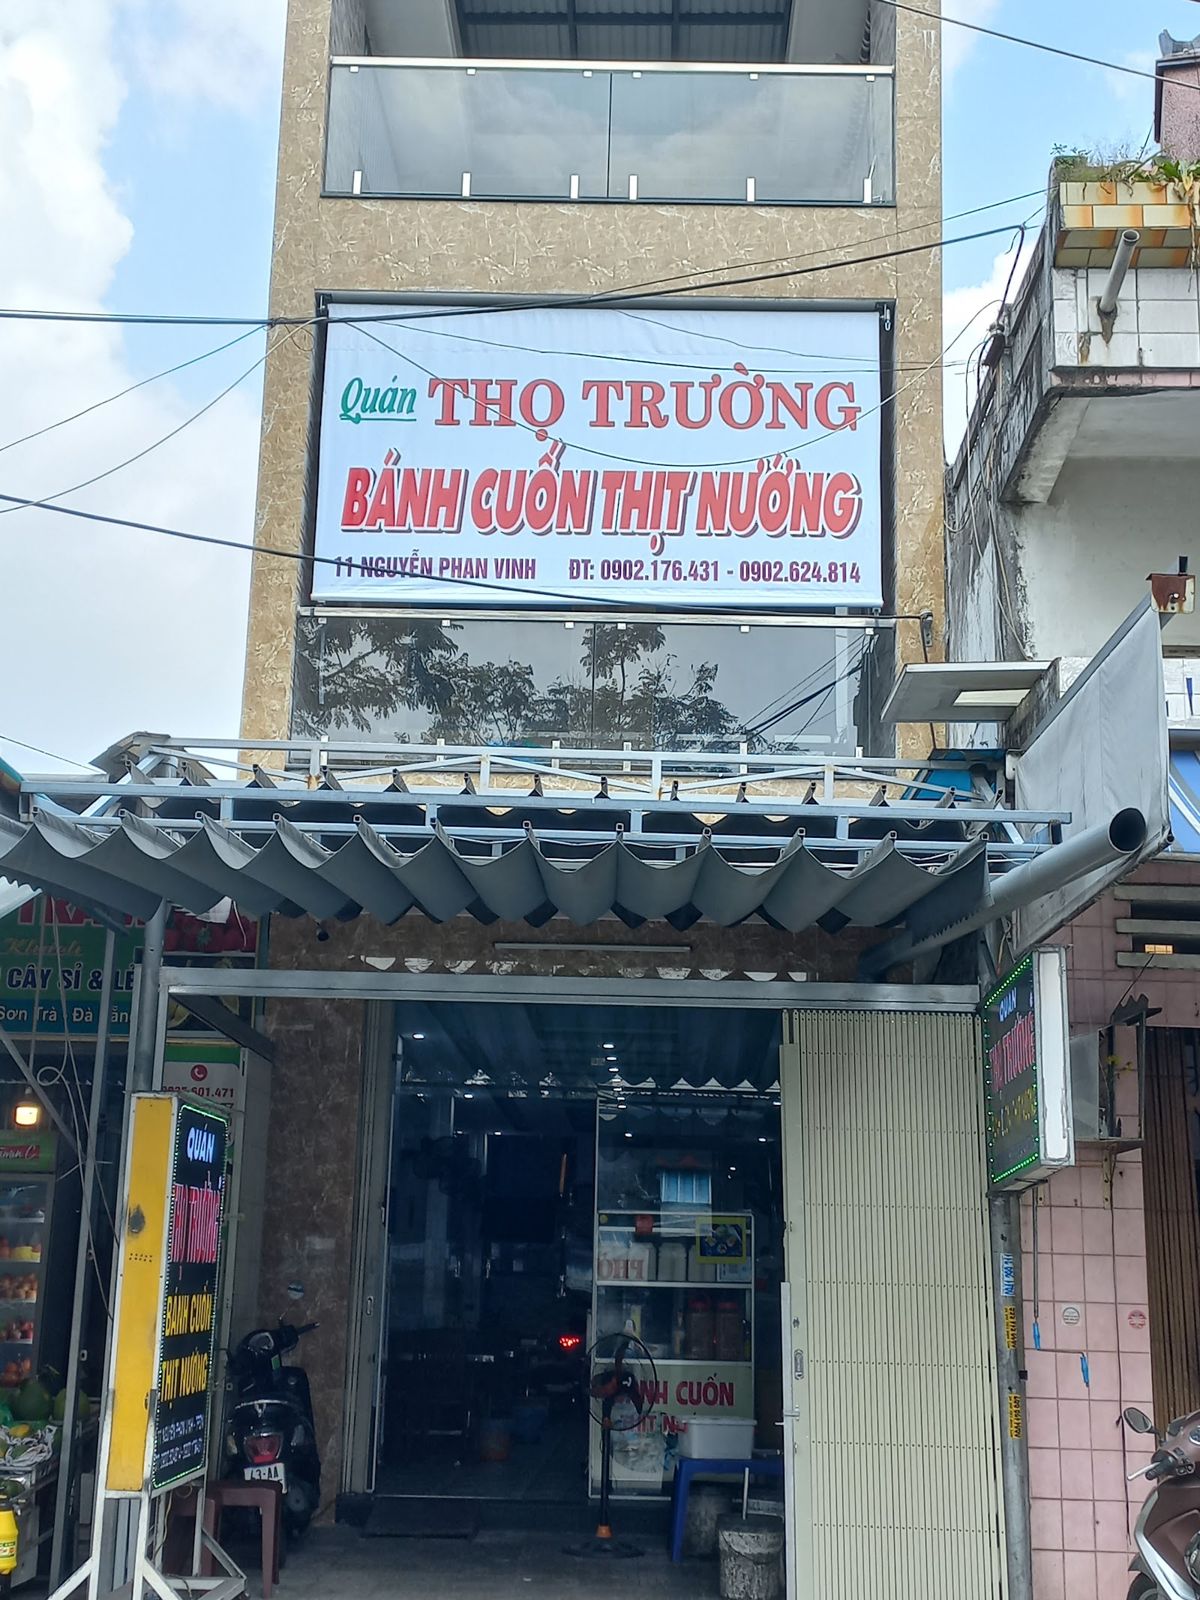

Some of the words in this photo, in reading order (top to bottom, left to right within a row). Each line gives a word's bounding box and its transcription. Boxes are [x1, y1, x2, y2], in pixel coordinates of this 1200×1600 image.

[339, 375, 417, 424] Quán
[428, 378, 565, 442] THỌ
[582, 362, 862, 431] TRƯỜNG
[341, 448, 469, 535] BÁNH
[470, 438, 599, 536] CUỐN
[600, 470, 697, 556] THỊT
[695, 451, 863, 539] NƯỚNG
[334, 556, 353, 578] 11
[360, 549, 433, 579] NGUYỄN
[438, 557, 489, 579] PHAN
[494, 558, 536, 580] VINH
[569, 558, 594, 581] ĐT:
[600, 559, 719, 582] 0902.176.431
[739, 560, 861, 583] 0902.624.814
[7, 963, 52, 989] CÂY
[72, 1007, 93, 1022] Đà
[187, 1123, 215, 1164] QUÁN
[165, 1286, 190, 1337] BÁNH
[190, 1280, 213, 1334] CUỐN
[161, 1359, 181, 1410] THỊT
[675, 1373, 735, 1406] CUỐN
